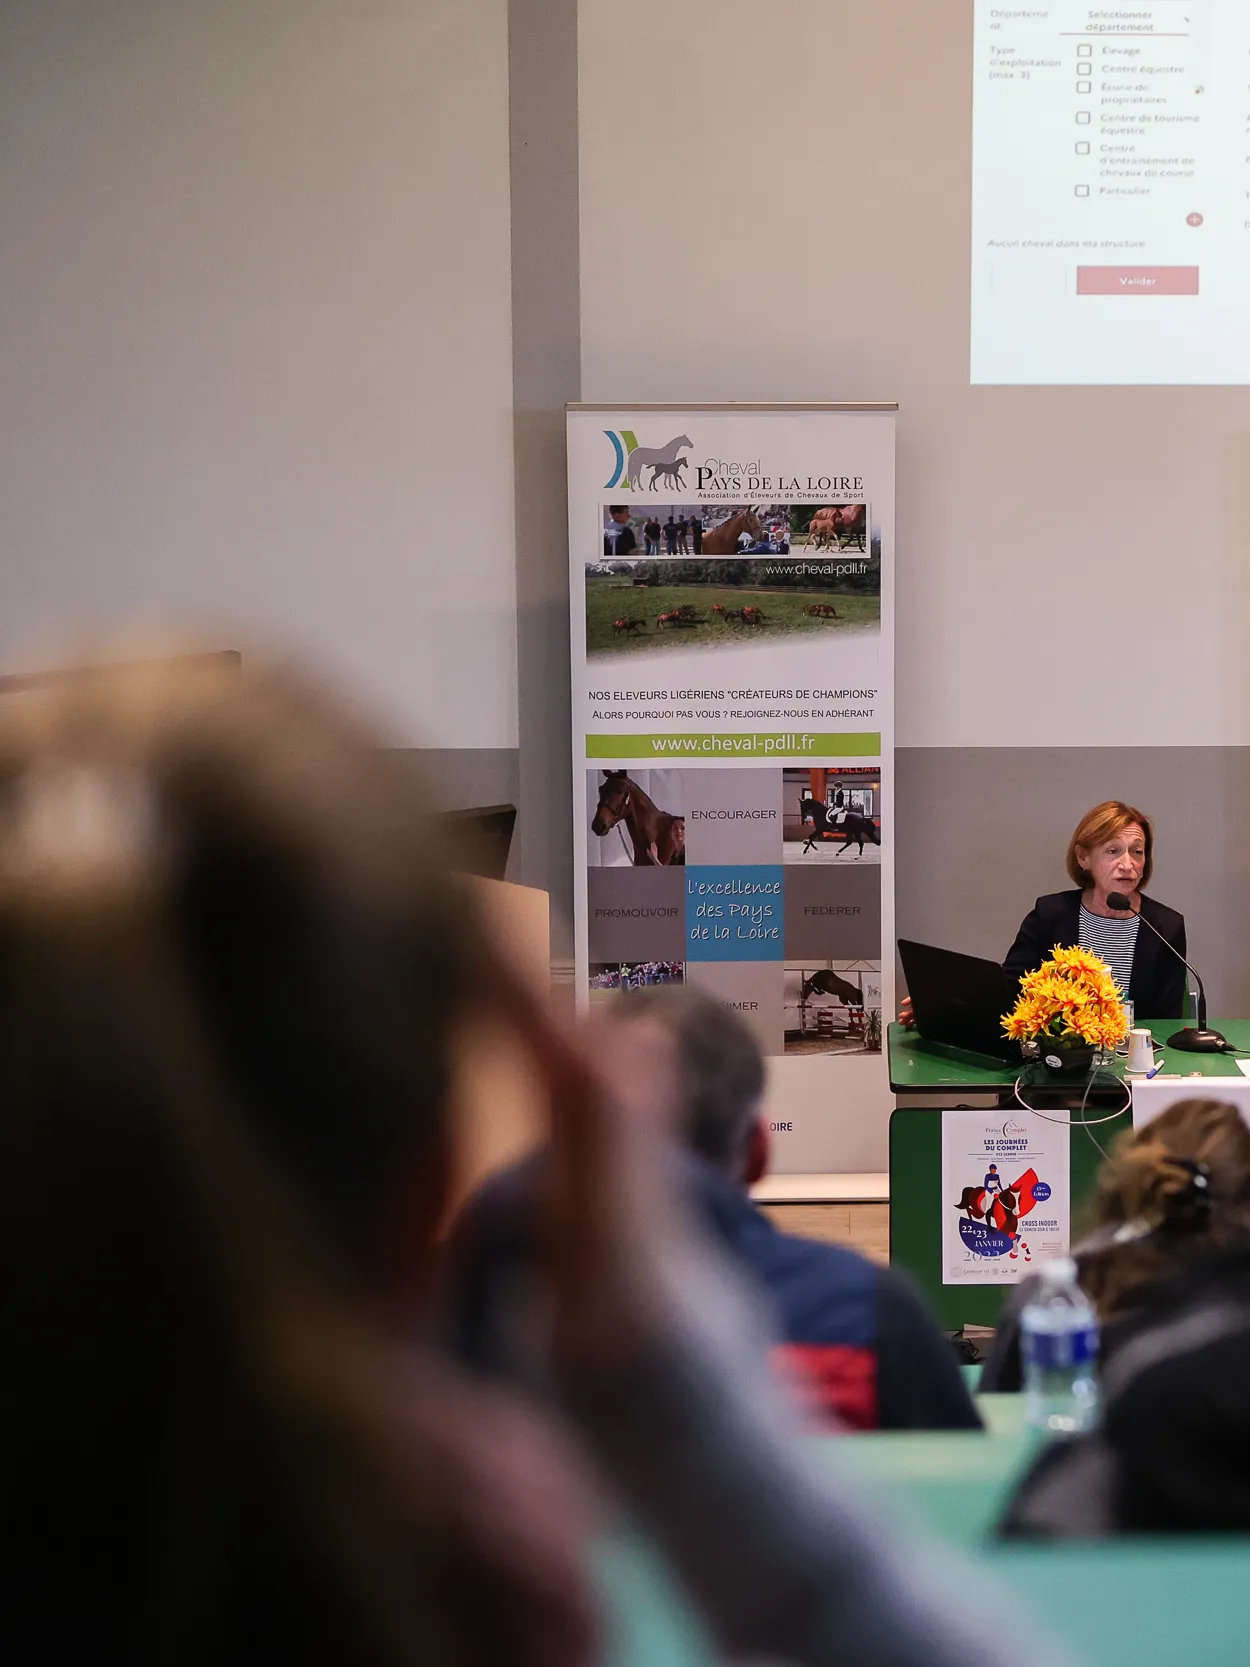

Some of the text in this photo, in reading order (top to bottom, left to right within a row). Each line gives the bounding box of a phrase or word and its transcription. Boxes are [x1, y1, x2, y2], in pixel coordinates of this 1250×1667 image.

[1088, 11, 1153, 19] Selectionner
[1085, 23, 1154, 32] département
[1119, 277, 1156, 285] Valider
[705, 458, 761, 475] Cheval
[765, 563, 868, 576] www.cheval-pdll.fr
[589, 687, 878, 700] NOS ELEVEURS LIGÉRIENS "CRÉATEURS DE CHAMPIONS"
[592, 708, 874, 720] ALORS POURQUOI PAS VOUS ? REJOIGNEZ-NOUS EN ADHÉRANT
[652, 735, 815, 752] www.cheval-pdll.fr
[691, 809, 777, 820] ENCOURAGER
[687, 878, 781, 895] l'excellence
[594, 908, 678, 918] PROMOUVOIR
[696, 903, 773, 924] des Pays
[804, 906, 861, 916] FEDERER
[690, 923, 779, 940] de la Loire
[770, 1122, 792, 1131] OIRE
[976, 1230, 987, 1239] 23
[964, 1251, 1000, 1261] 2022
